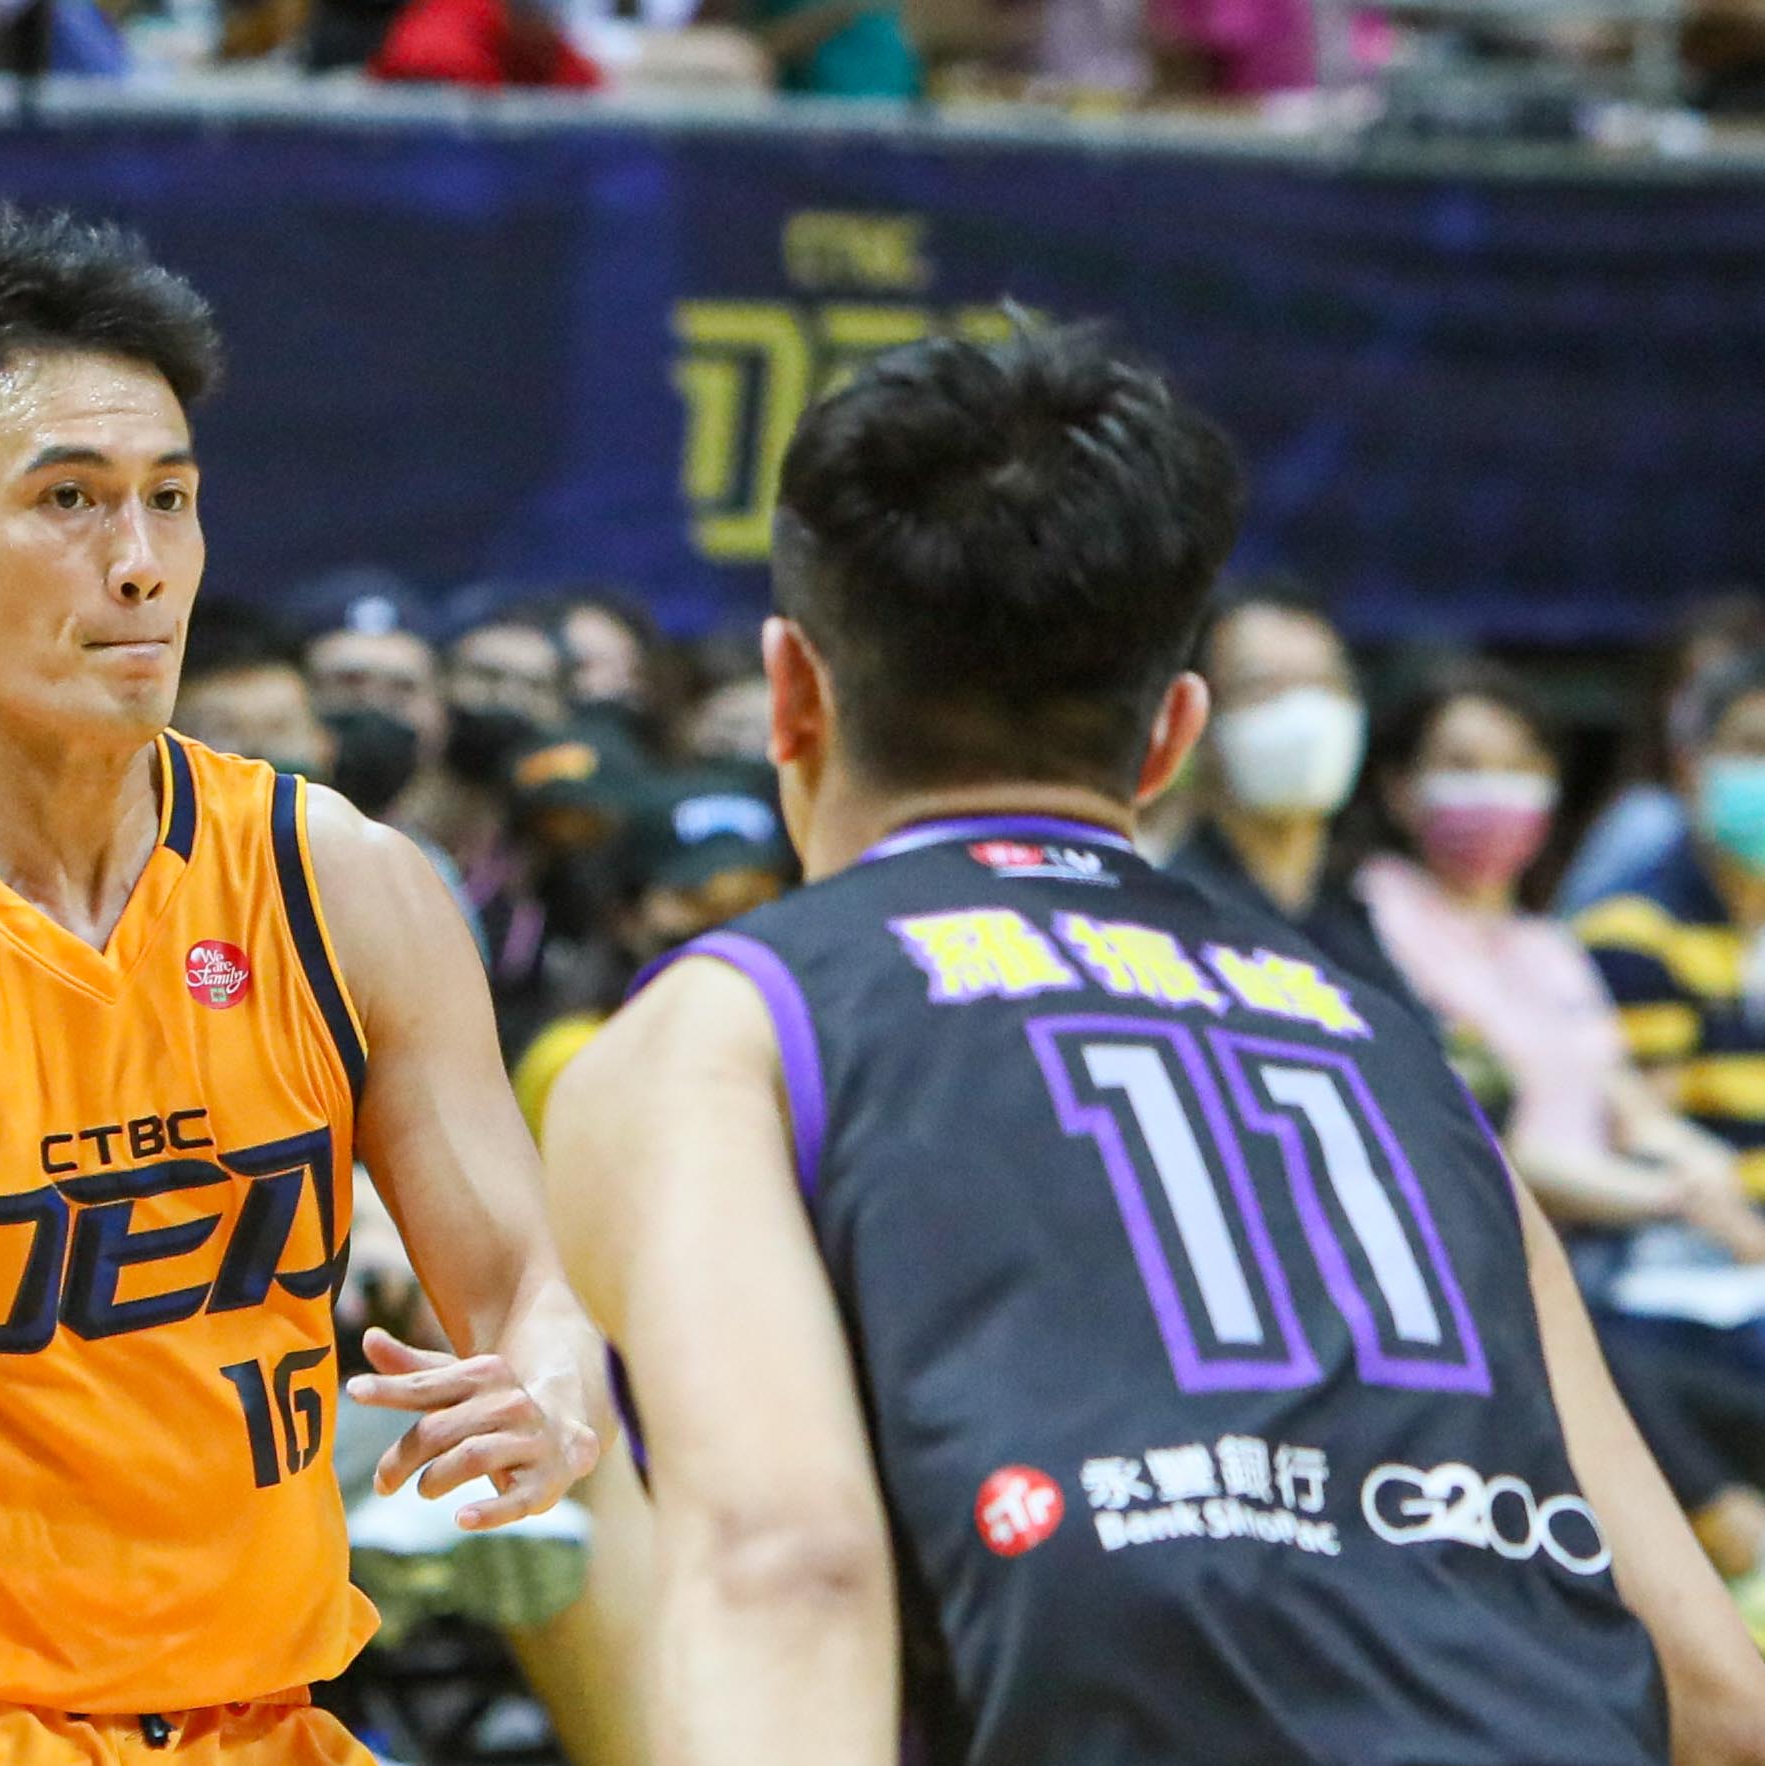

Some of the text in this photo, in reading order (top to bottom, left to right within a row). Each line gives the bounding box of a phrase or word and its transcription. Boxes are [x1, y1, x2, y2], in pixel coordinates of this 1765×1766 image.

[186, 966, 249, 994] Family
[40, 1108, 215, 1175] CTBC
[1026, 1013, 1494, 1396] 11
[219, 1346, 332, 1490] 16
